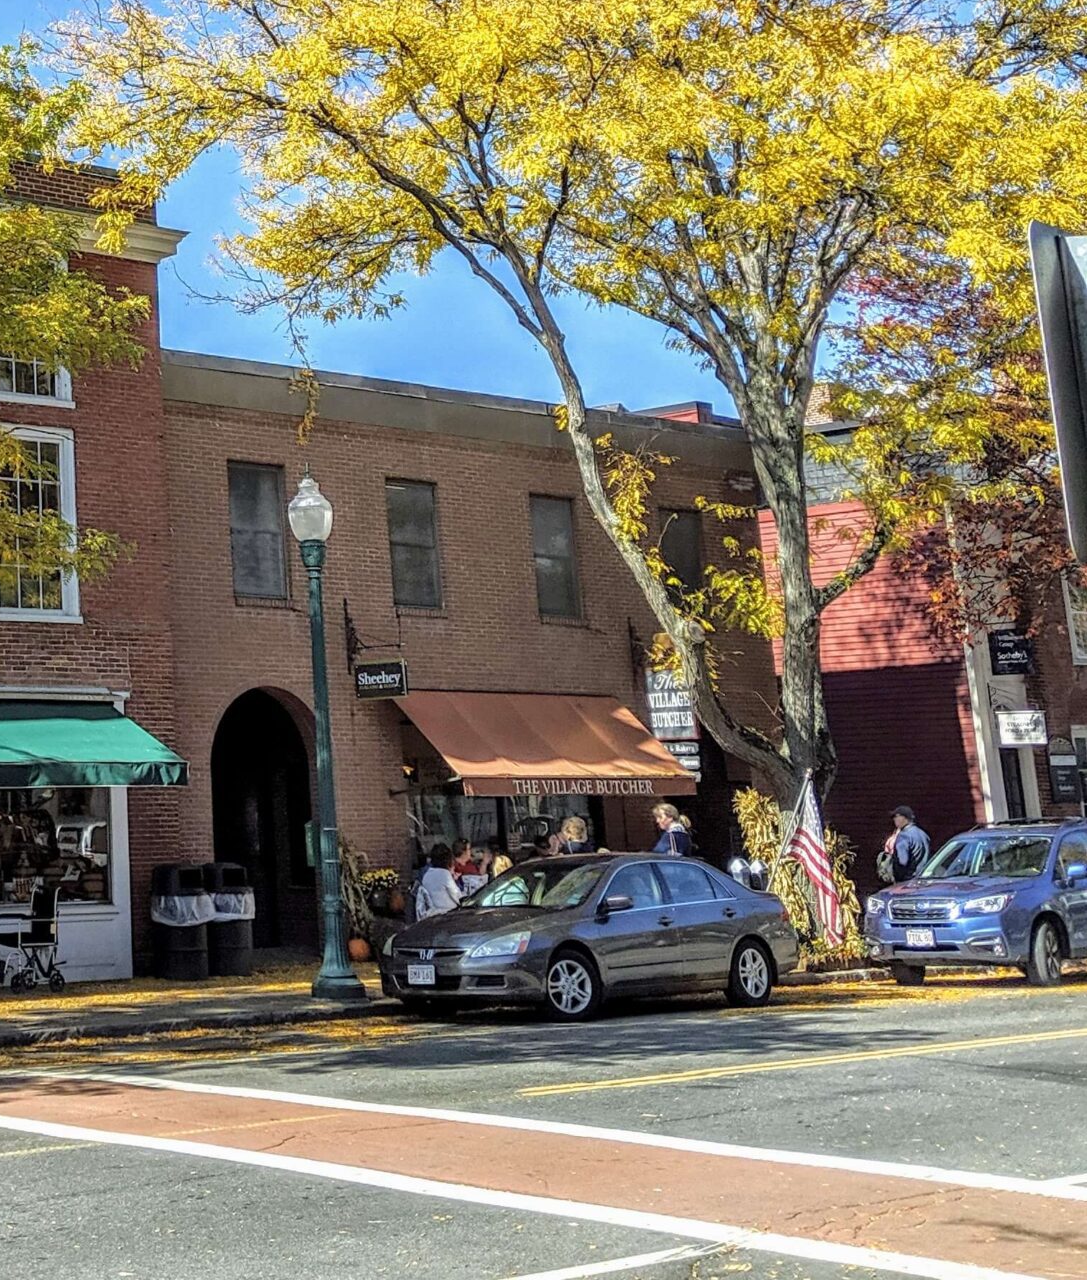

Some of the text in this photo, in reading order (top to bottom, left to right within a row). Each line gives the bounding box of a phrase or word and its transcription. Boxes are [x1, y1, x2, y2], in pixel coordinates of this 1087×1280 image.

[358, 671, 401, 687] Sheehey
[654, 673, 682, 690] The
[648, 691, 690, 709] VILLAGE
[651, 711, 694, 728] BUTCHER
[513, 780, 655, 795] THE VILLAGE BUTCHER
